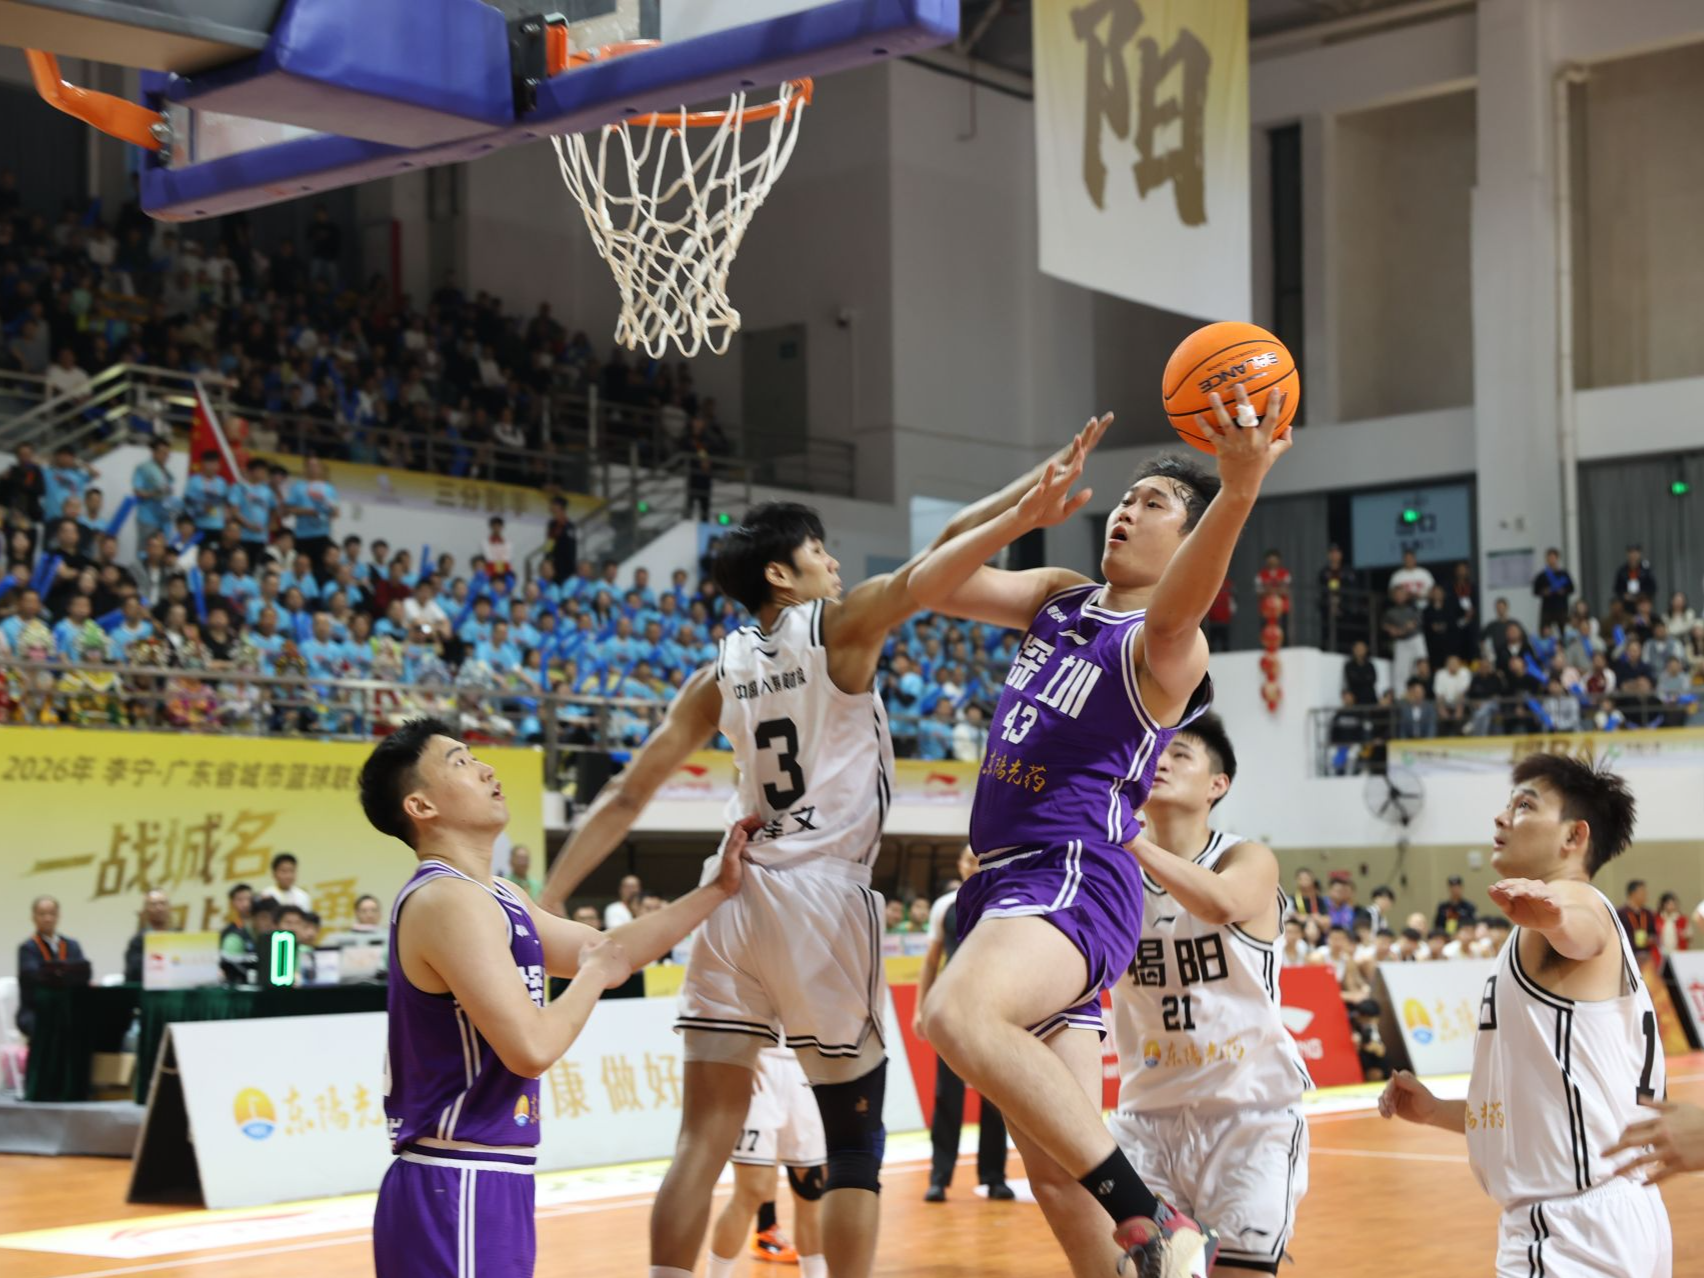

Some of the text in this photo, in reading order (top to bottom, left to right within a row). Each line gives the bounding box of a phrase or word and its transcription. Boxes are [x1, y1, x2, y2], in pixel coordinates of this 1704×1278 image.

[1070, 0, 1211, 228] 阳
[1001, 701, 1038, 744] 43
[755, 717, 806, 811] 3
[270, 930, 296, 987] 0
[1162, 994, 1196, 1031] 21
